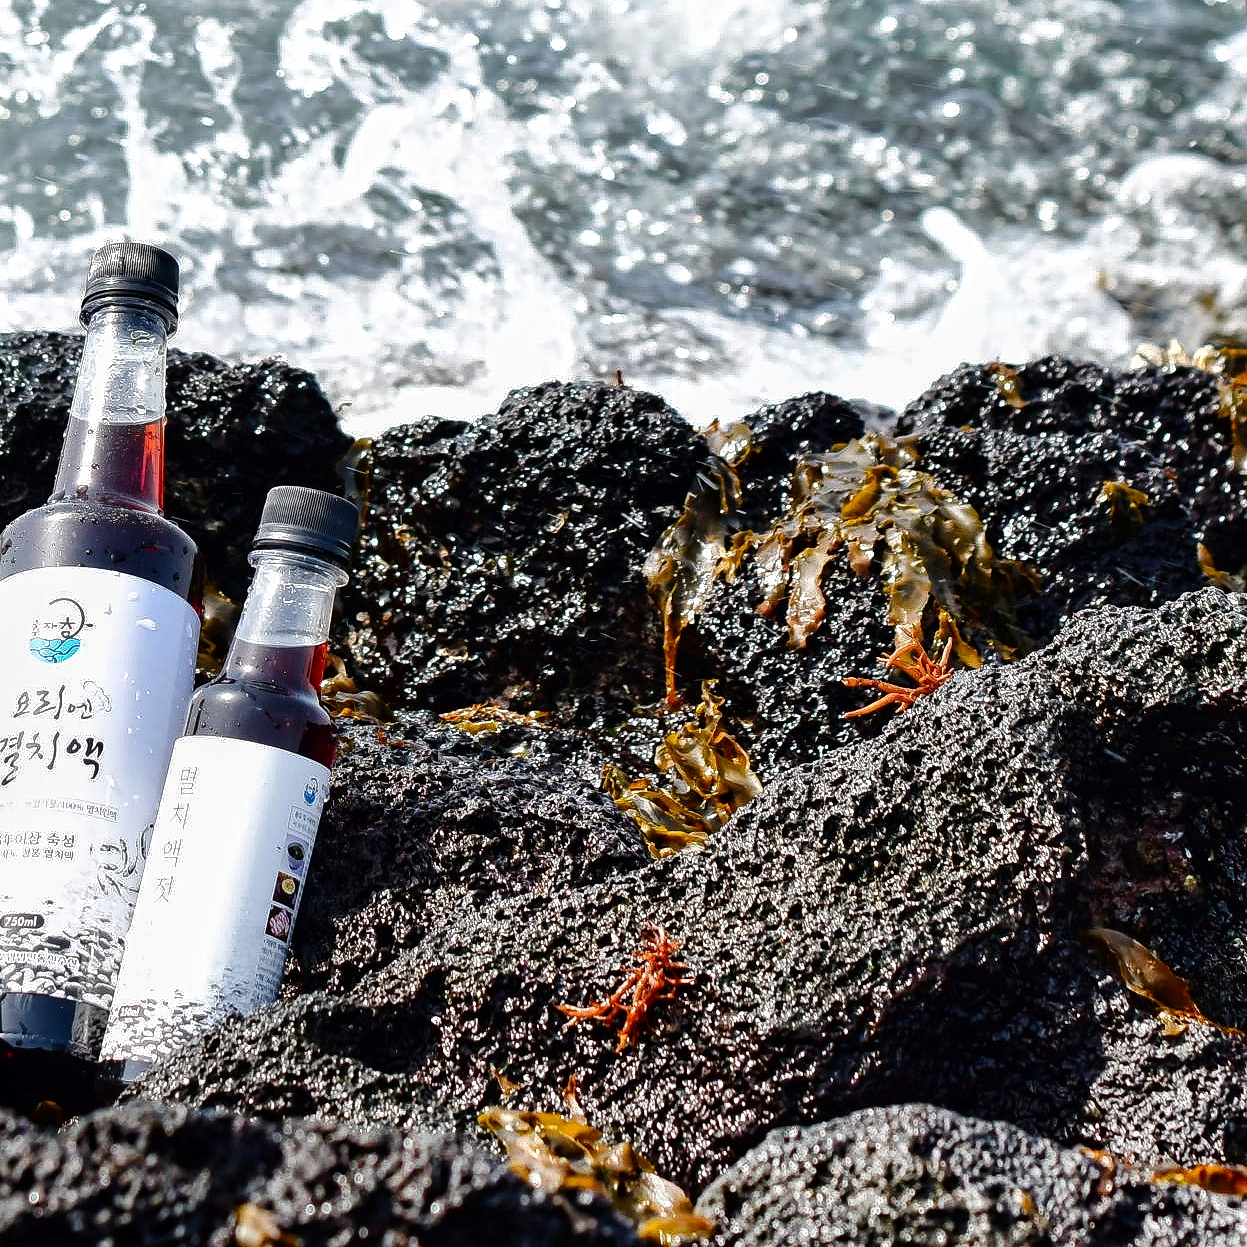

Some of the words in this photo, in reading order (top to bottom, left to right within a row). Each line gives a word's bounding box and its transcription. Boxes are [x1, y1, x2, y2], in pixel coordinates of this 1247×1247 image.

[13, 685, 93, 720] 요리엔
[46, 832, 76, 849] 숙성
[4, 916, 38, 928] 750ml
